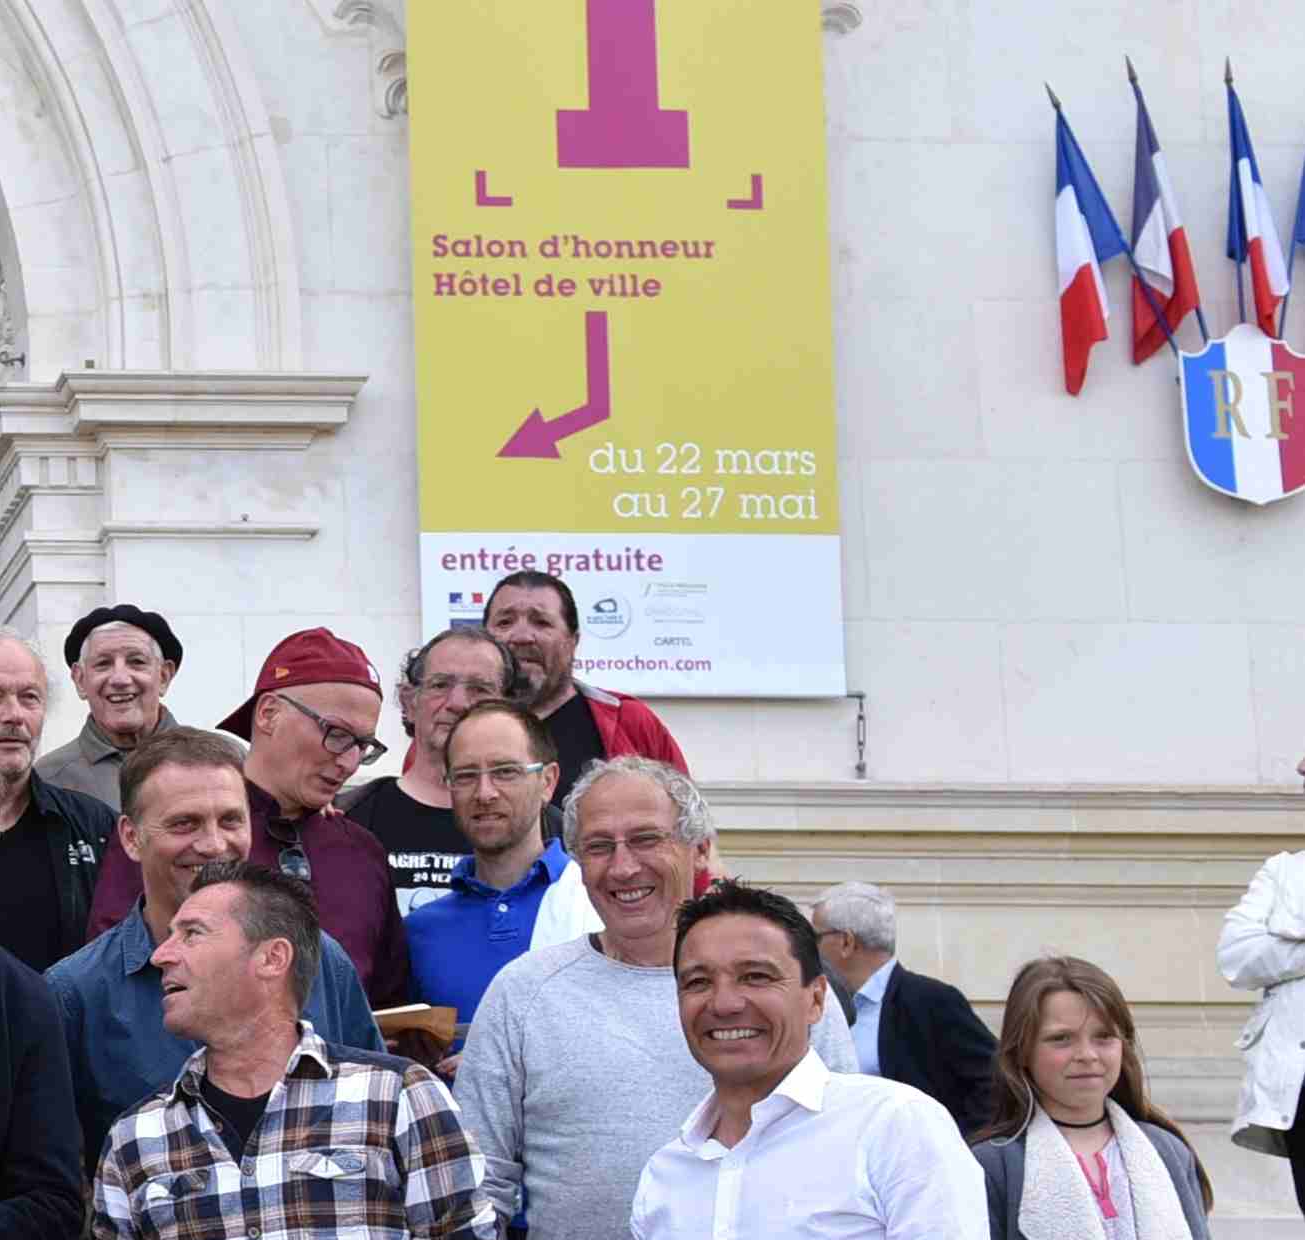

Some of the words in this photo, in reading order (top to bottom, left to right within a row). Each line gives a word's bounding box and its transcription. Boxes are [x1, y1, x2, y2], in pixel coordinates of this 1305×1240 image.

[432, 234, 527, 259] Salon
[538, 234, 716, 260] d'honneur
[433, 270, 522, 297] Hôtel
[534, 274, 577, 297] de
[589, 274, 662, 298] ville
[590, 443, 644, 474] du
[656, 443, 703, 474] 22
[715, 450, 817, 475] mars
[612, 494, 667, 519] au
[681, 488, 725, 519] 27
[739, 488, 819, 520] mai
[441, 546, 536, 571] entrée
[546, 547, 664, 576] gratuite
[574, 655, 712, 672] aperochon.com
